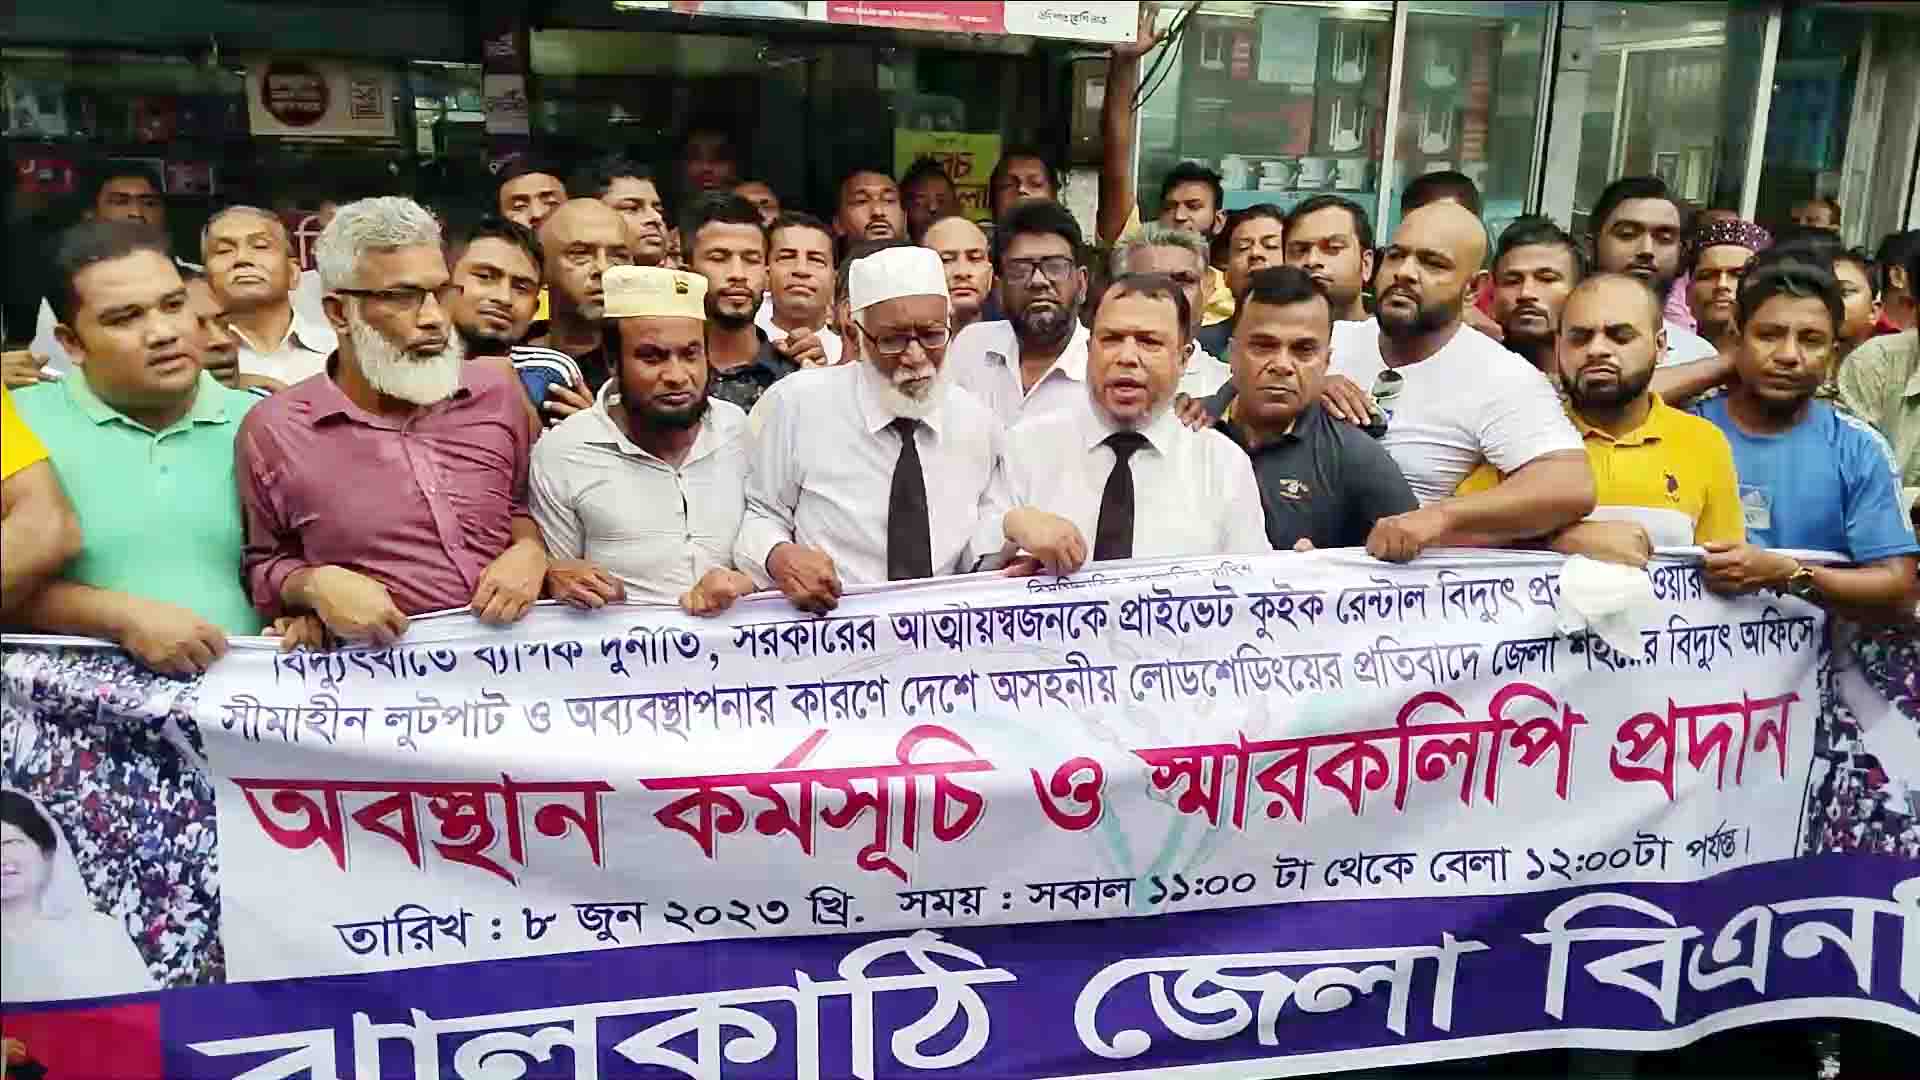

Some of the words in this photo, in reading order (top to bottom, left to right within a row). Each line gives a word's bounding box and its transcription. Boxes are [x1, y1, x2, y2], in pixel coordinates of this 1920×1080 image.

[731, 612, 878, 657] সরকারের
[1119, 579, 1239, 639] প্রাইভেট
[1247, 572, 1325, 640] কুইক
[1336, 574, 1428, 625] রেন্টাল
[1437, 570, 1521, 630] বিদ্যুৎ
[220, 693, 373, 743] সীমাহীন
[384, 687, 511, 751] লুটপাট
[523, 701, 553, 733] ও
[565, 683, 778, 743] অব্যবস্থাপনার
[786, 673, 889, 723] কারণে
[900, 668, 977, 718] দেশে
[987, 650, 1118, 711] অসহনীয়
[1351, 636, 1482, 691] প্রতিবাদে
[1491, 634, 1560, 676] জেলা
[1667, 614, 1733, 672] বিদ্যুৎ
[1739, 606, 1817, 656] অফিসে
[229, 771, 616, 887] অবস্থান
[638, 723, 997, 883] কর্মসূচি
[1031, 756, 1108, 831] ও
[1132, 682, 1589, 832] স্মারকলিপি
[1609, 689, 1802, 801] প্রদান
[333, 904, 476, 959] তারিখ
[522, 907, 557, 941] ৮
[571, 899, 648, 944] জুন
[663, 899, 790, 931] ২০২৩
[808, 886, 865, 926] খ্রি.
[896, 886, 987, 918] সময়
[1026, 876, 1136, 913] সকাল
[1148, 872, 1257, 905] ১১:০০
[1273, 855, 1314, 891] টা
[1324, 850, 1417, 888] থেকে
[1429, 846, 1512, 885] বেলা
[1526, 831, 1673, 881] ১২:০০টা
[1073, 931, 1490, 1060] জেলা
